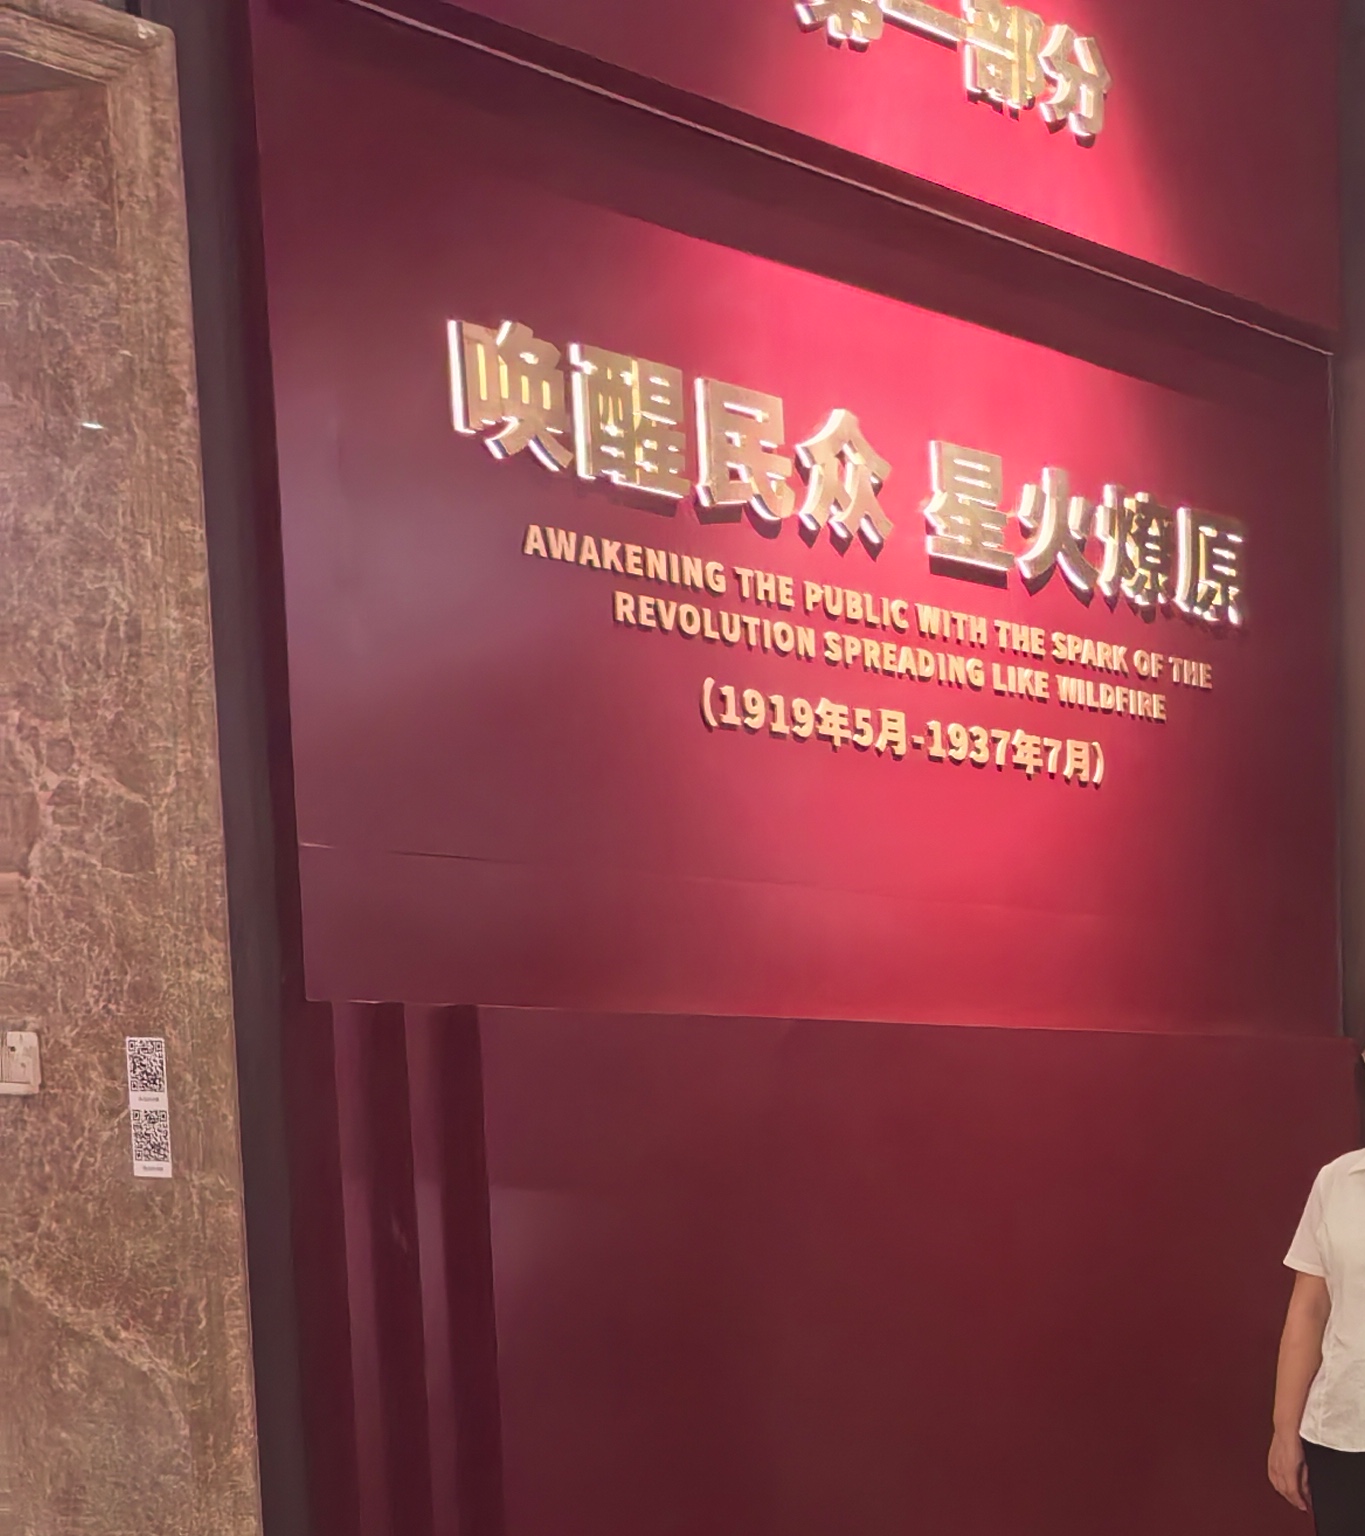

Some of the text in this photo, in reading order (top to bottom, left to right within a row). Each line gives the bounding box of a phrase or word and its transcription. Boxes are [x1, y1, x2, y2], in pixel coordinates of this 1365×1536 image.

[447, 318, 1247, 627] 唤醒民众 星火燎原
[523, 524, 1213, 690] AWAKENING THE PUBLIC WITH THE SPARK OF THE
[613, 591, 1167, 722] REVOLUTION SPREADING LIKE WILDFIRE
